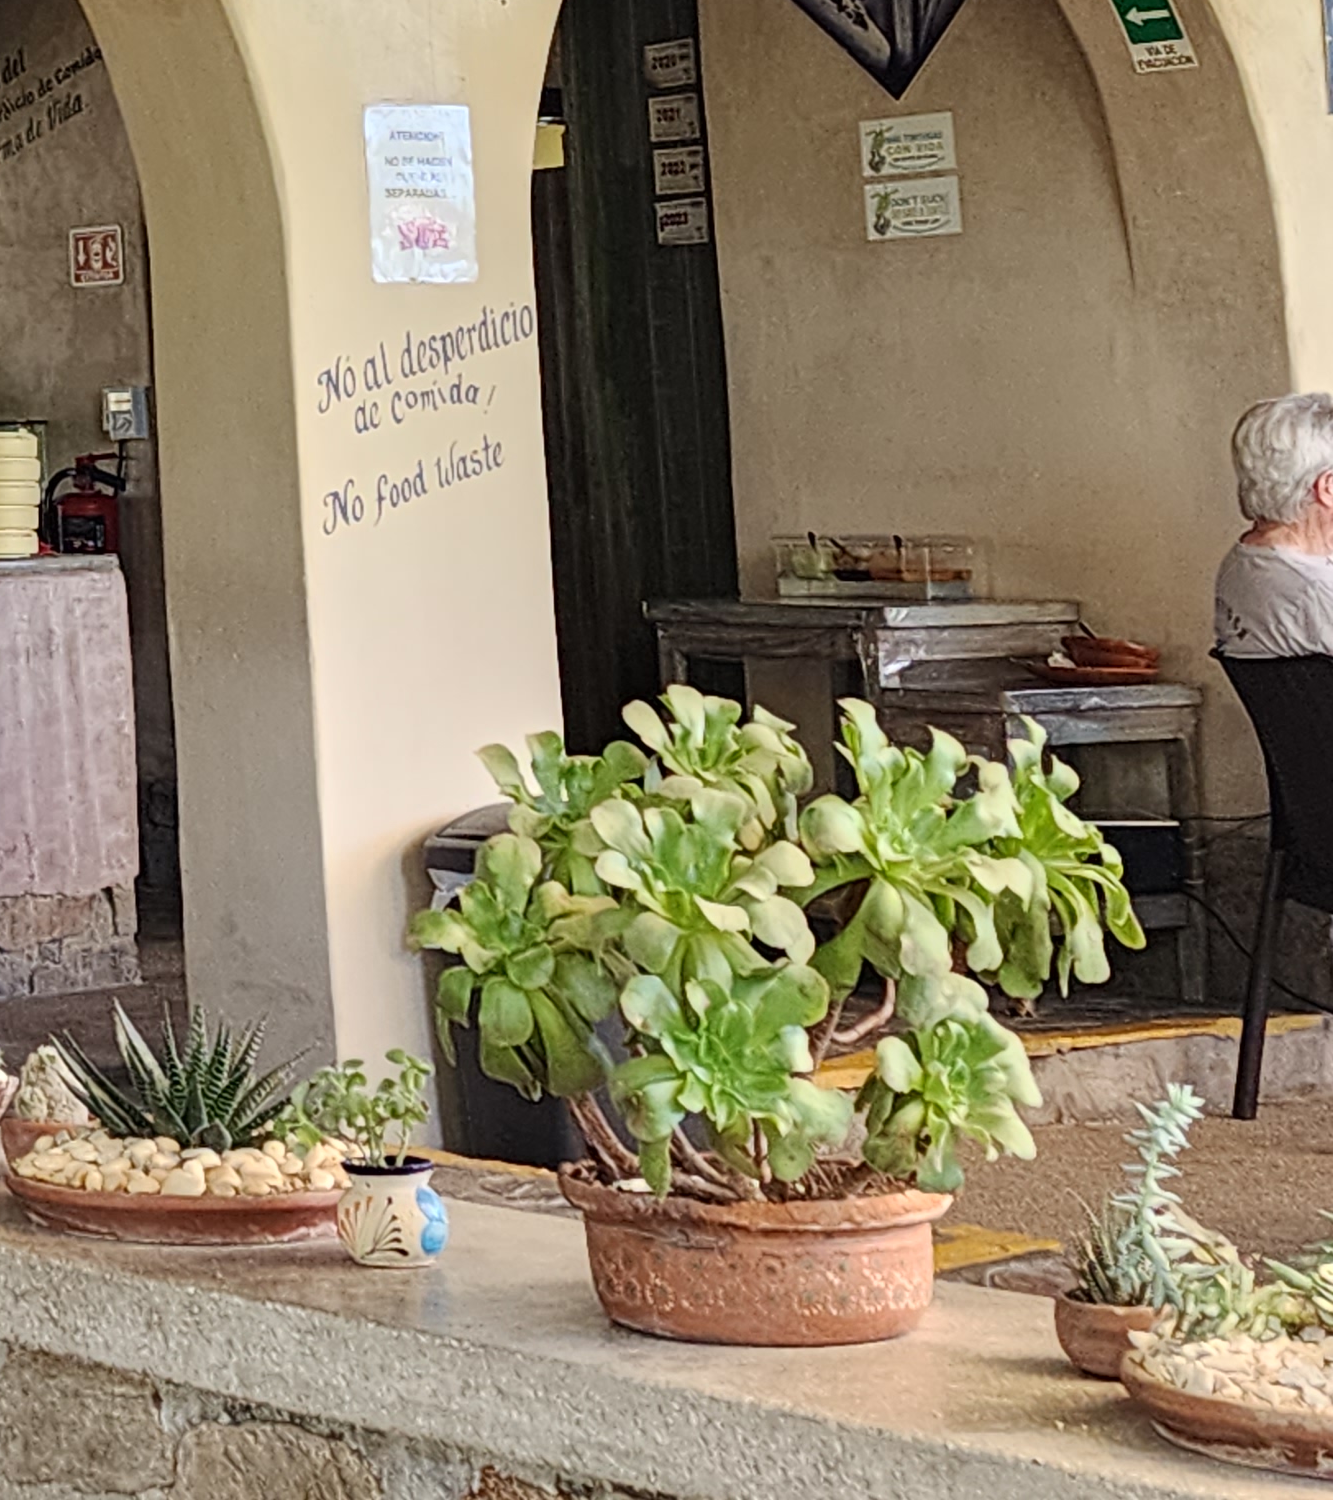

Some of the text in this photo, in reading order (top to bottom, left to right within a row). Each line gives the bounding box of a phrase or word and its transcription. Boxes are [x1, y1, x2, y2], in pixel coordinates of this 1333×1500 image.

[1, 46, 27, 85] del
[37, 77, 53, 99] de
[25, 115, 43, 145] de
[363, 340, 393, 392] al
[400, 301, 534, 375] desperdicio
[353, 398, 382, 434] de
[322, 478, 365, 536] No
[373, 459, 430, 528] food
